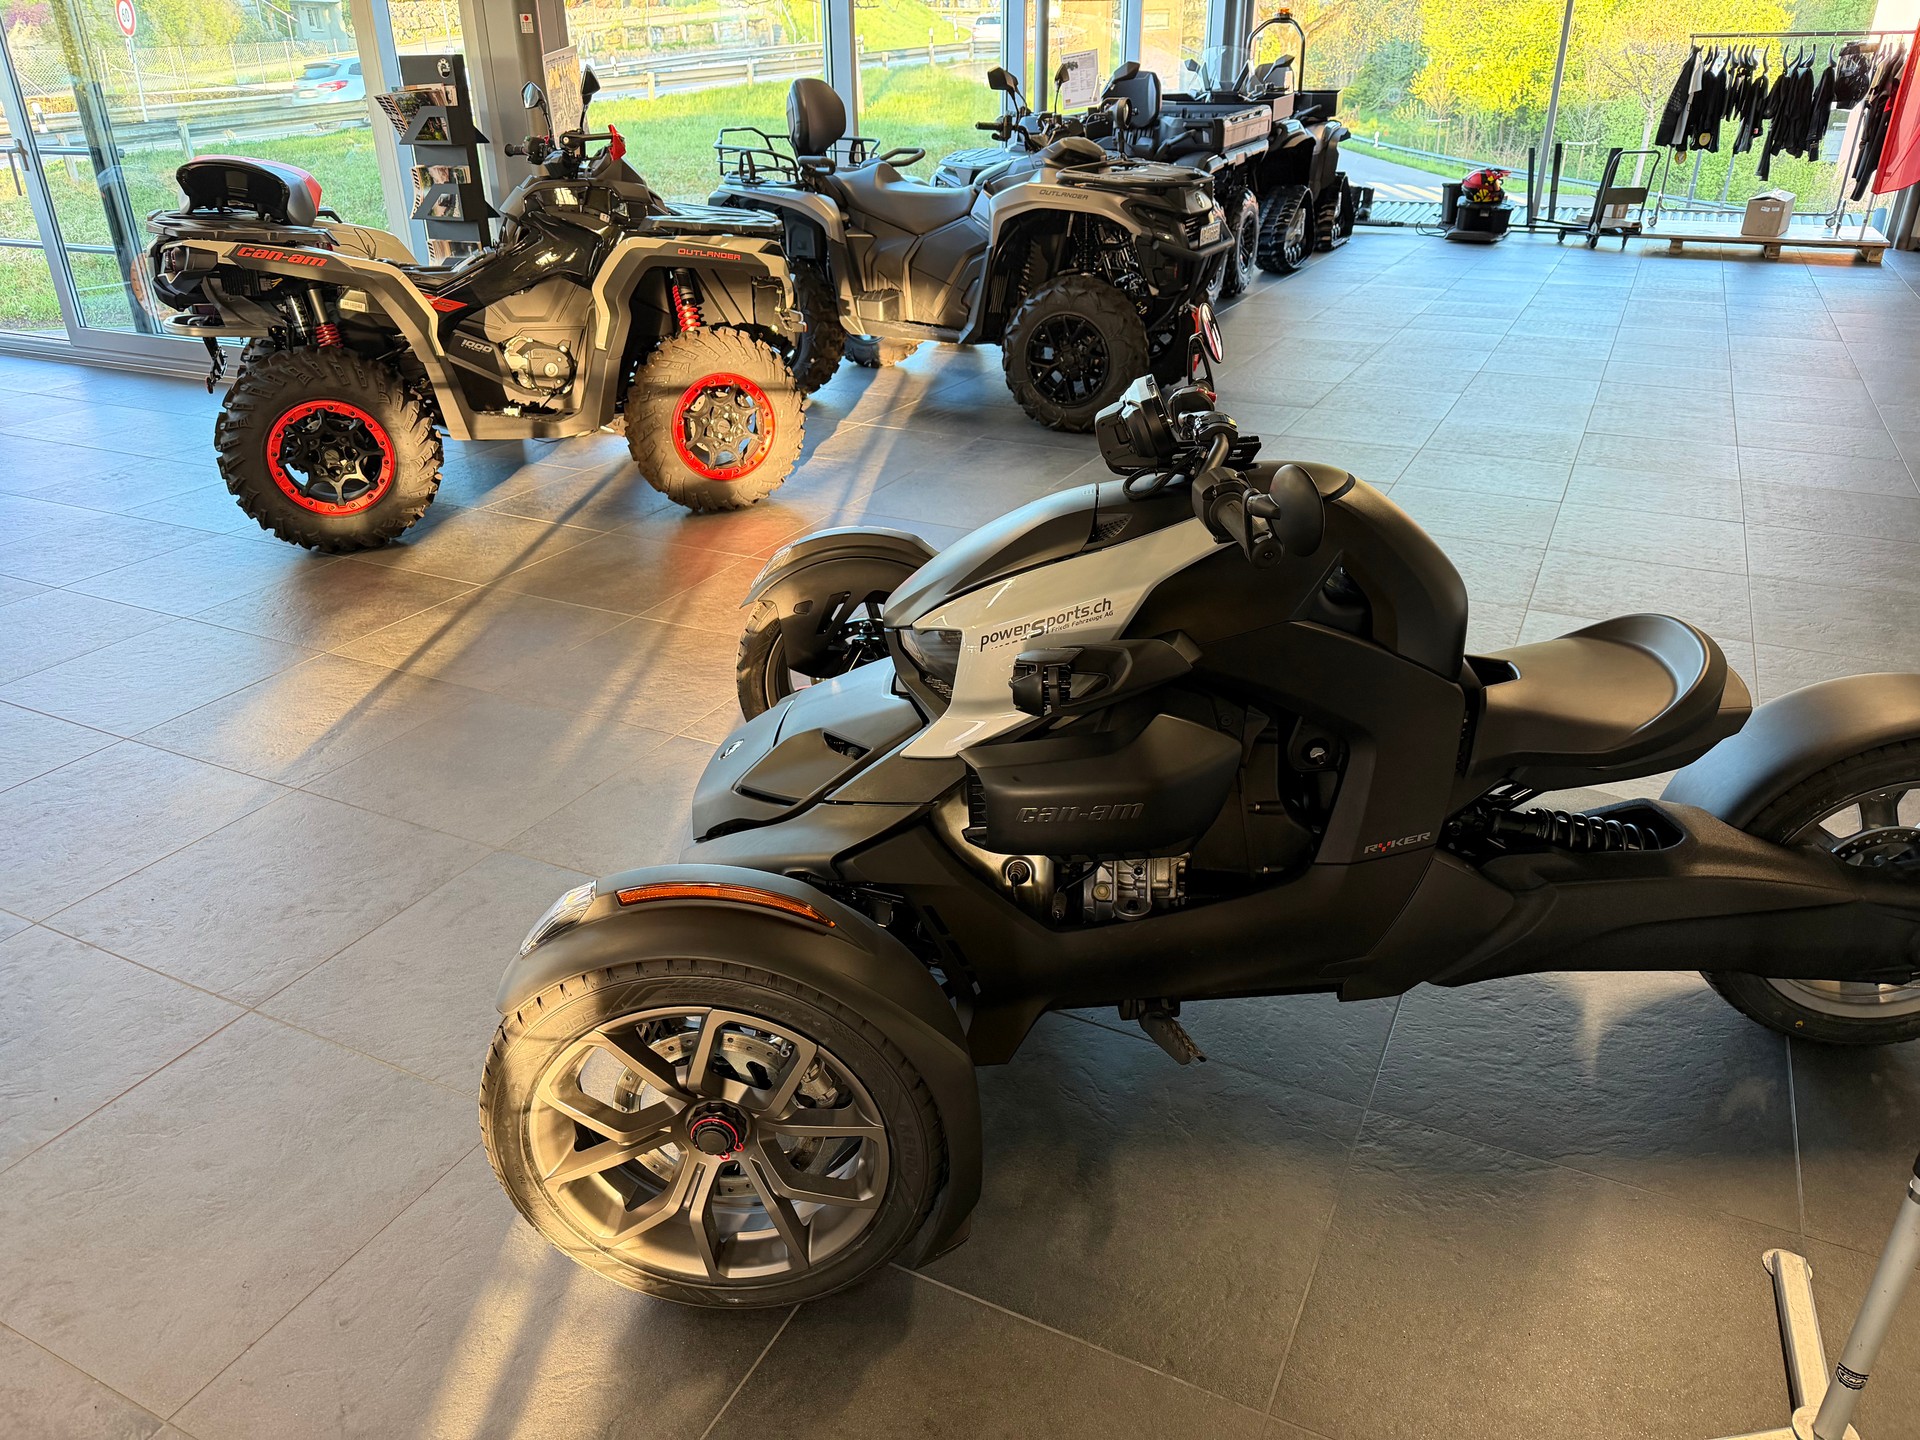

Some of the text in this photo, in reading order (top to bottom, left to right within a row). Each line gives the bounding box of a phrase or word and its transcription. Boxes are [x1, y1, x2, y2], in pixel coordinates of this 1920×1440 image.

[1039, 189, 1089, 200] OUTLANDER
[237, 247, 328, 267] can-am
[677, 247, 741, 260] OUTLANDER
[460, 338, 493, 353] 1000
[1016, 803, 1144, 822] can-am
[1363, 832, 1431, 854] RYKER
